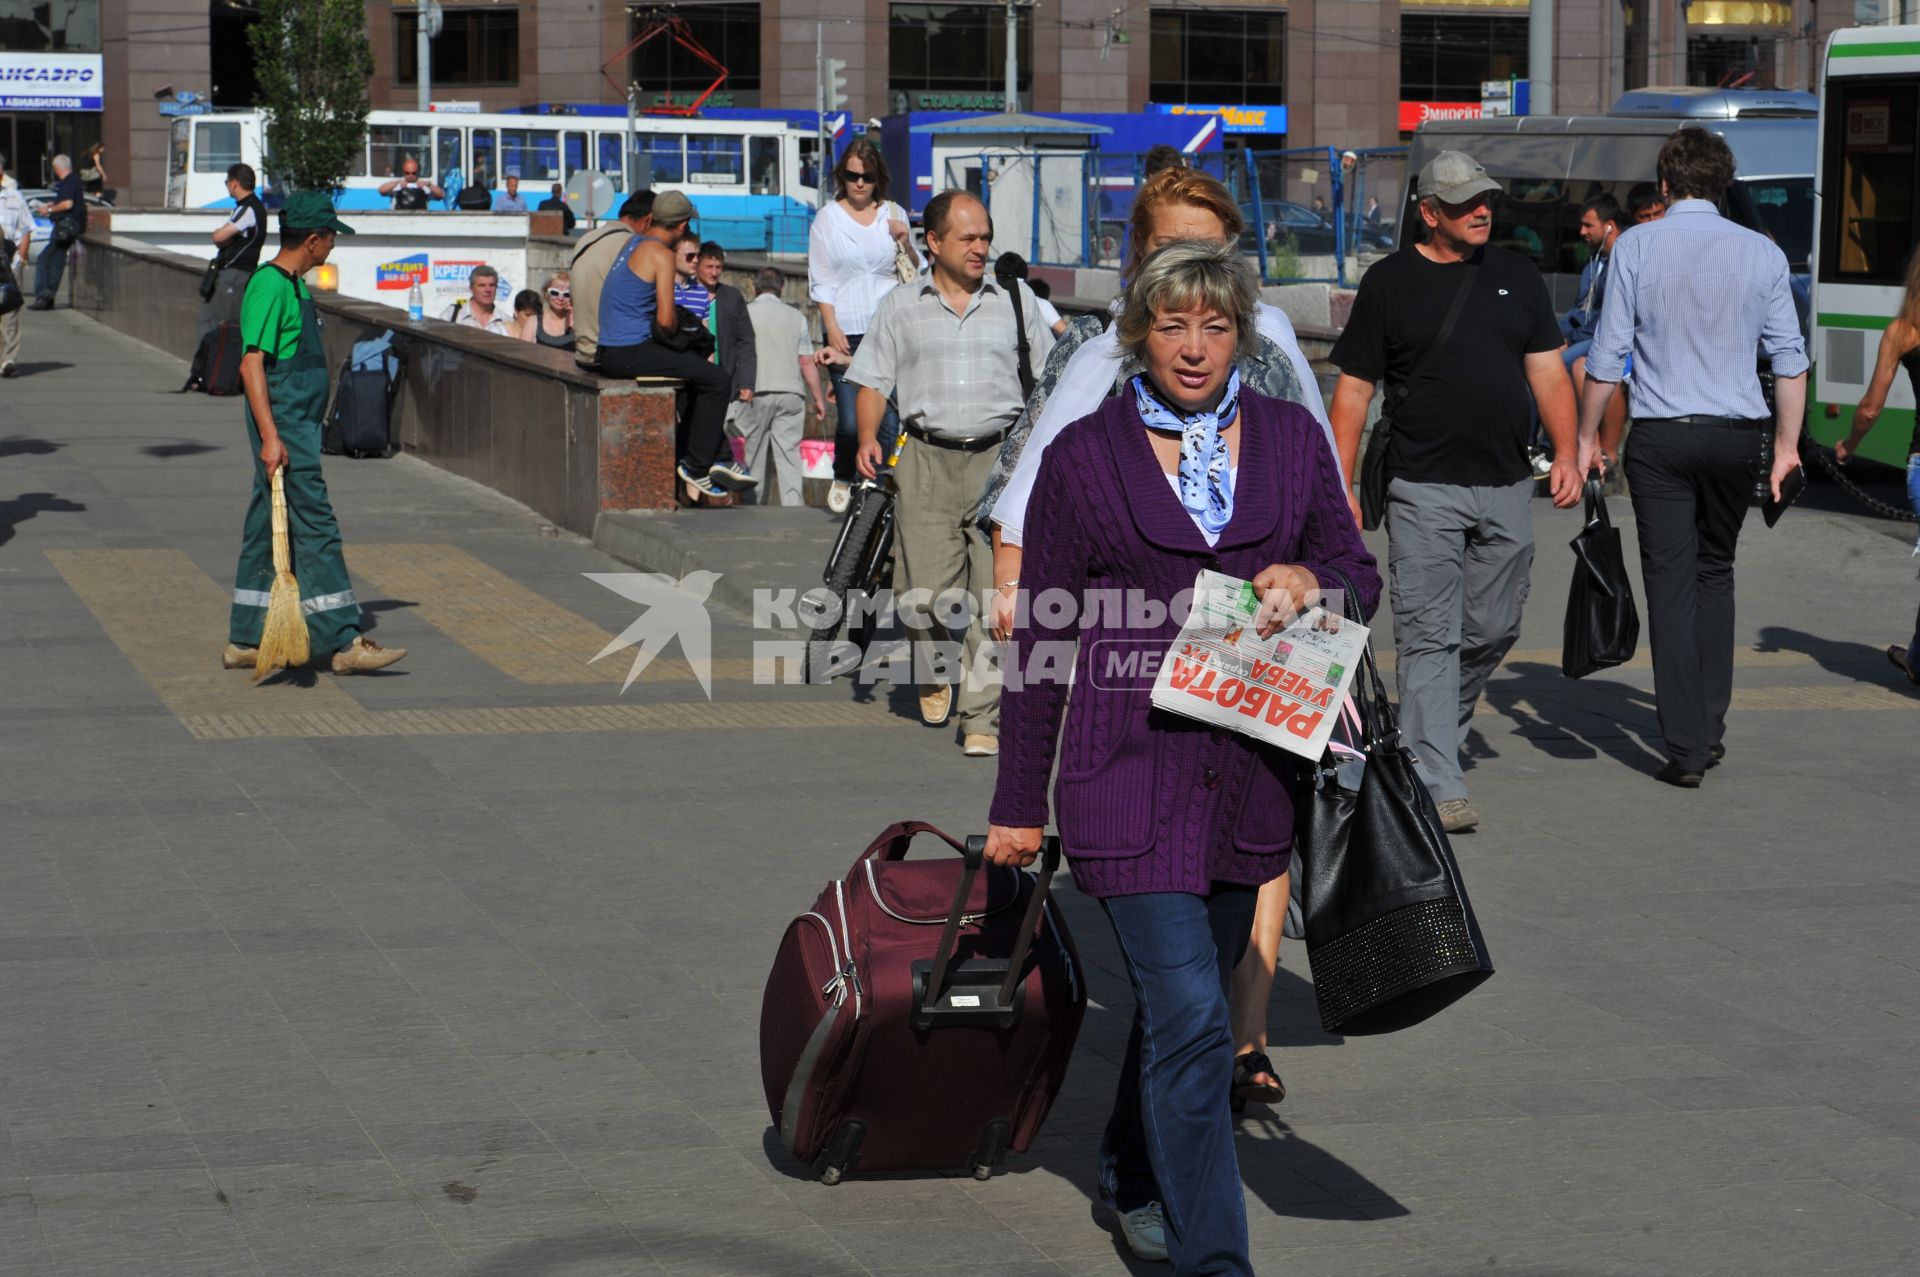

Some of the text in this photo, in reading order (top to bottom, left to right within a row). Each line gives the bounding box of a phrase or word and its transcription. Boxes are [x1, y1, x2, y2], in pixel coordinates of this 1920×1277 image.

[381, 262, 424, 273] КРЕДИТ
[1169, 656, 1324, 740] РАБОТА
[1249, 657, 1337, 708] УЧЕБА
